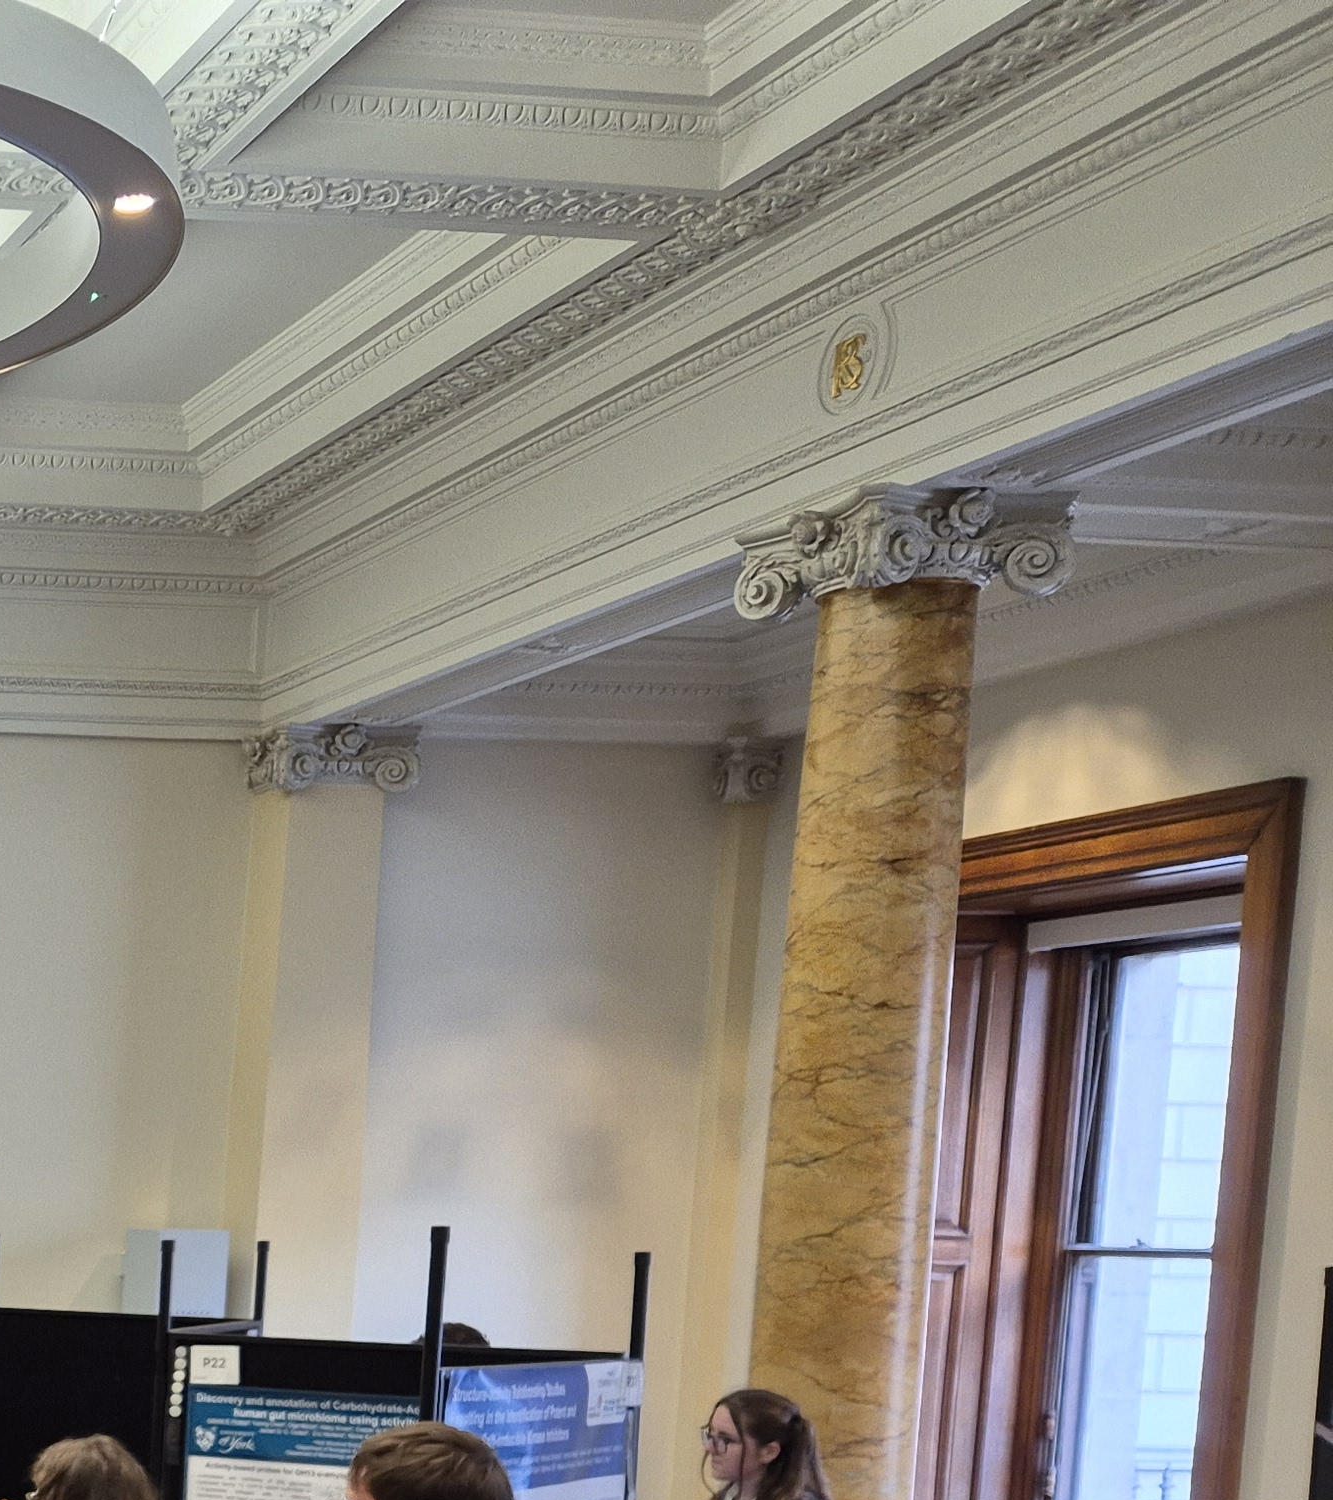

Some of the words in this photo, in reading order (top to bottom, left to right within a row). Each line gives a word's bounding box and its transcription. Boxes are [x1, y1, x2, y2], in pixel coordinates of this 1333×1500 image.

[203, 1357, 226, 1369] P22
[196, 1392, 243, 1406] Discovery
[245, 1396, 264, 1406] and
[266, 1398, 318, 1409] annotation
[320, 1400, 331, 1409] of
[234, 1408, 266, 1419] human
[268, 1410, 286, 1421] gut
[287, 1411, 346, 1424] microbiome
[349, 1415, 378, 1427] using
[380, 1417, 419, 1428] activity
